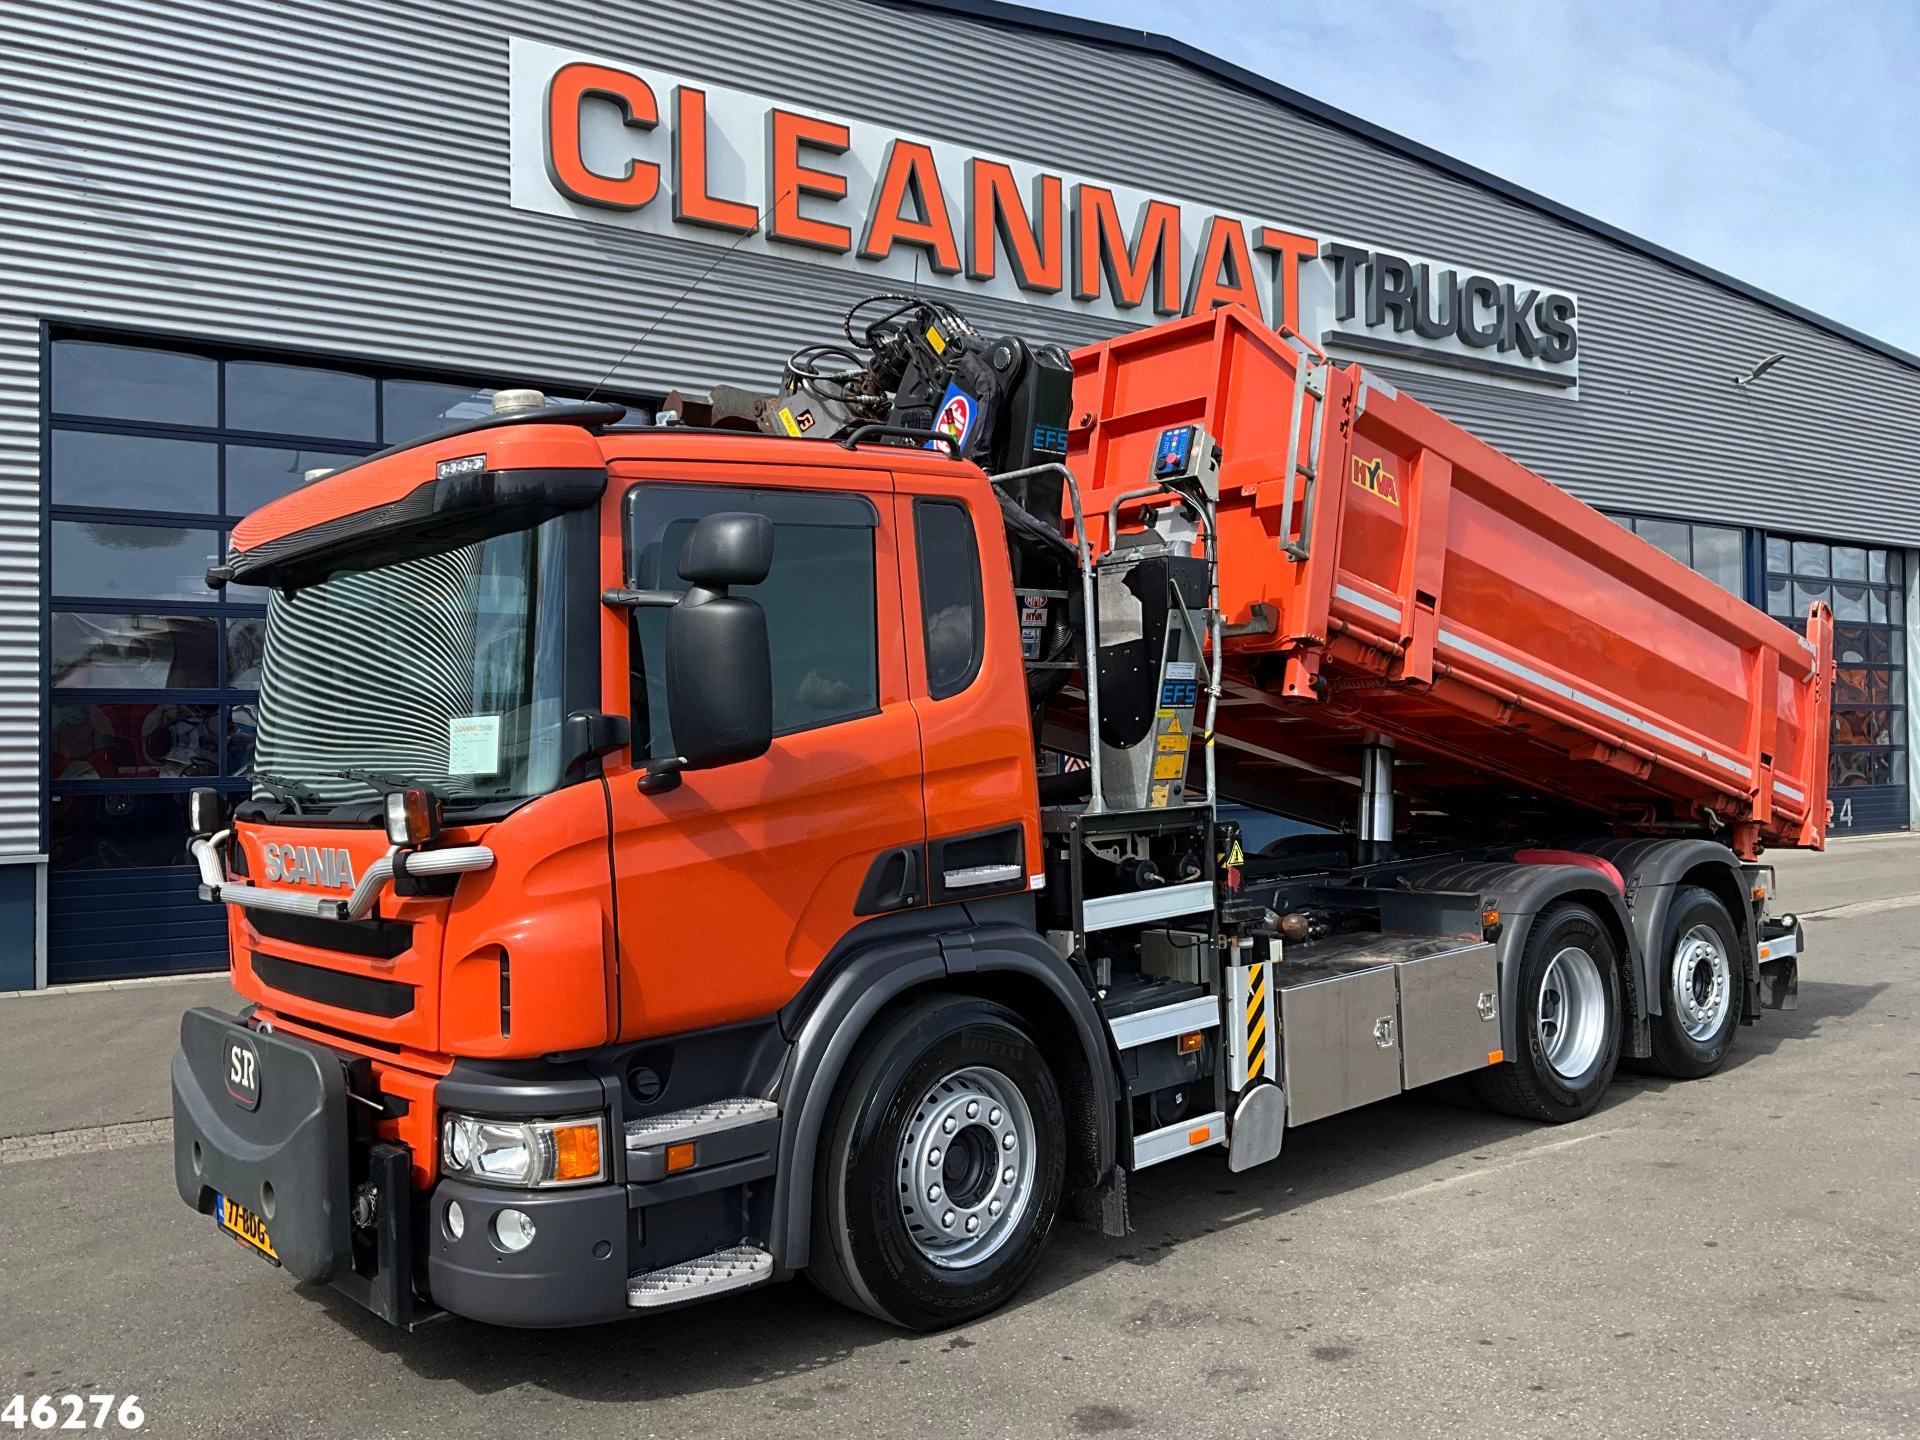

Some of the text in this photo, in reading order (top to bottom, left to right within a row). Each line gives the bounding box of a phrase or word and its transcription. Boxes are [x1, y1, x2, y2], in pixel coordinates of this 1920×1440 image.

[545, 62, 1577, 363] CLEANMAT TRUCKS
[1033, 428, 1068, 451] EFS
[1353, 459, 1398, 503] HYVA
[1025, 609, 1043, 621] HYVA
[1161, 685, 1197, 703] EFS
[265, 842, 356, 890] SCANIA
[230, 1045, 256, 1091] SR
